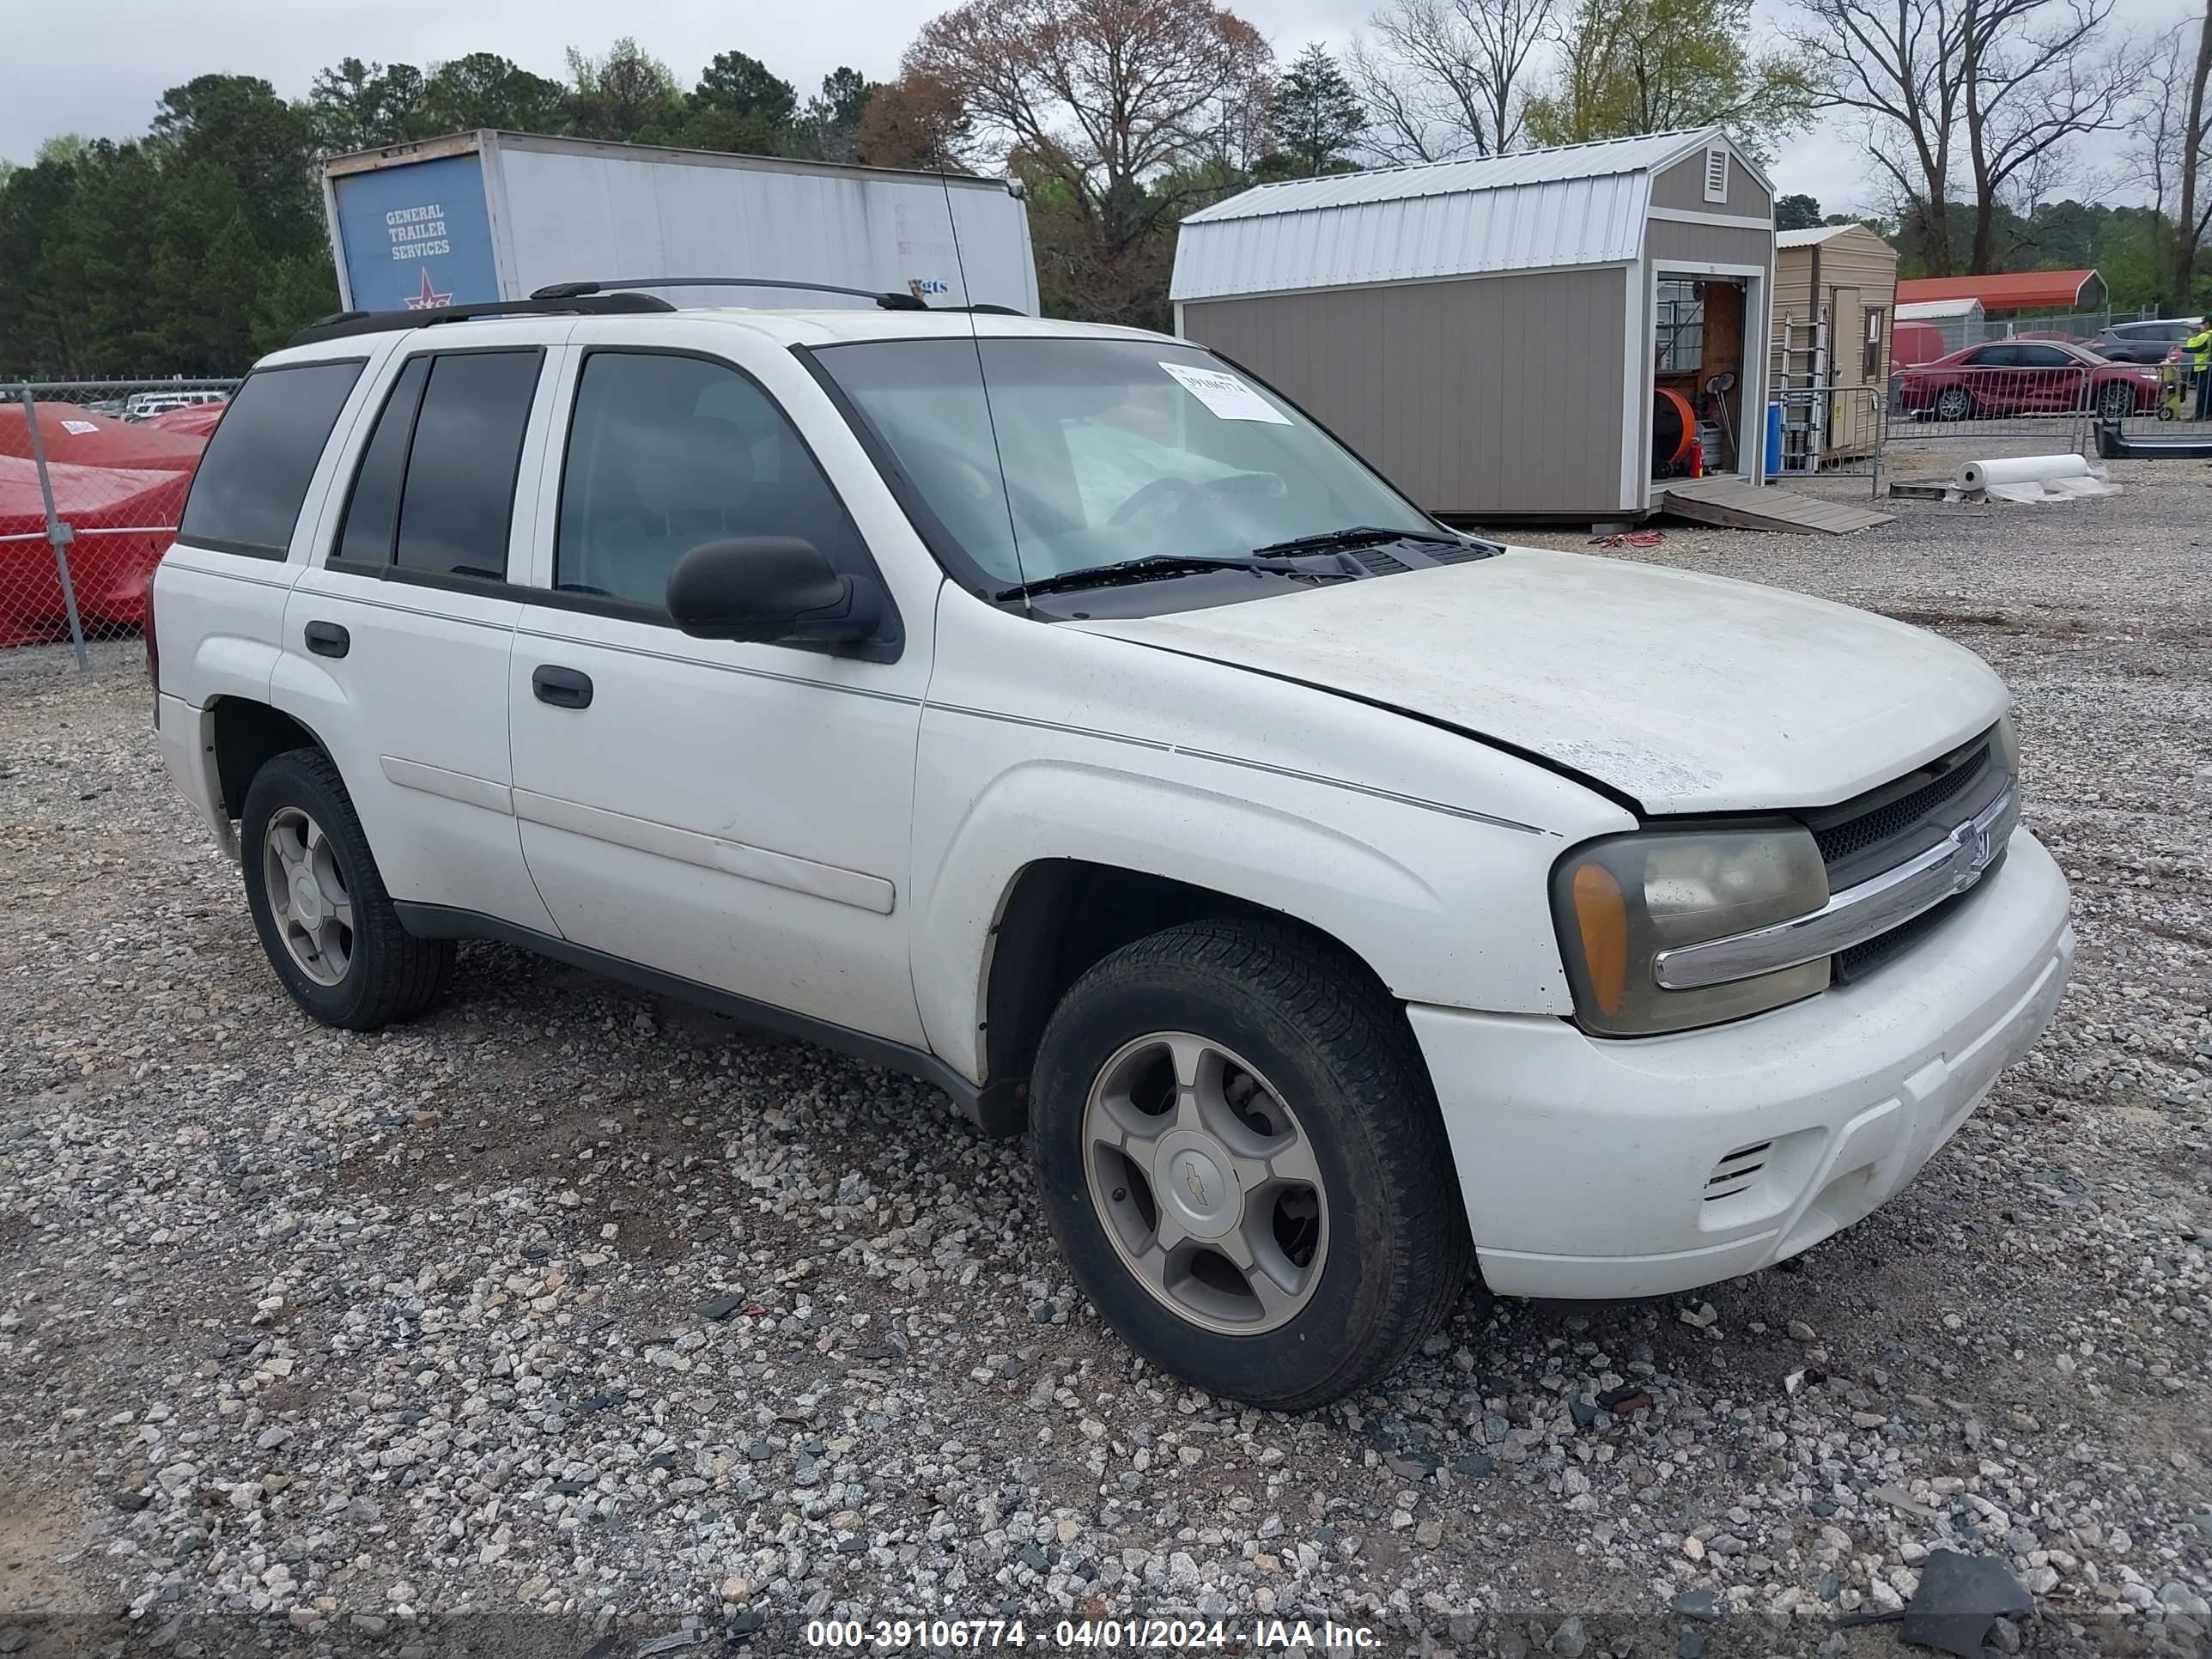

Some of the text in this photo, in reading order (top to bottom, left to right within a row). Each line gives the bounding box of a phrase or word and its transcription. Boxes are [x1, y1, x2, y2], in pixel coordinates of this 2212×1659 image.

[386, 204, 445, 225] GENERAL
[388, 221, 447, 242] TRAILER
[392, 240, 450, 260] SERVICES
[922, 280, 949, 295] gts
